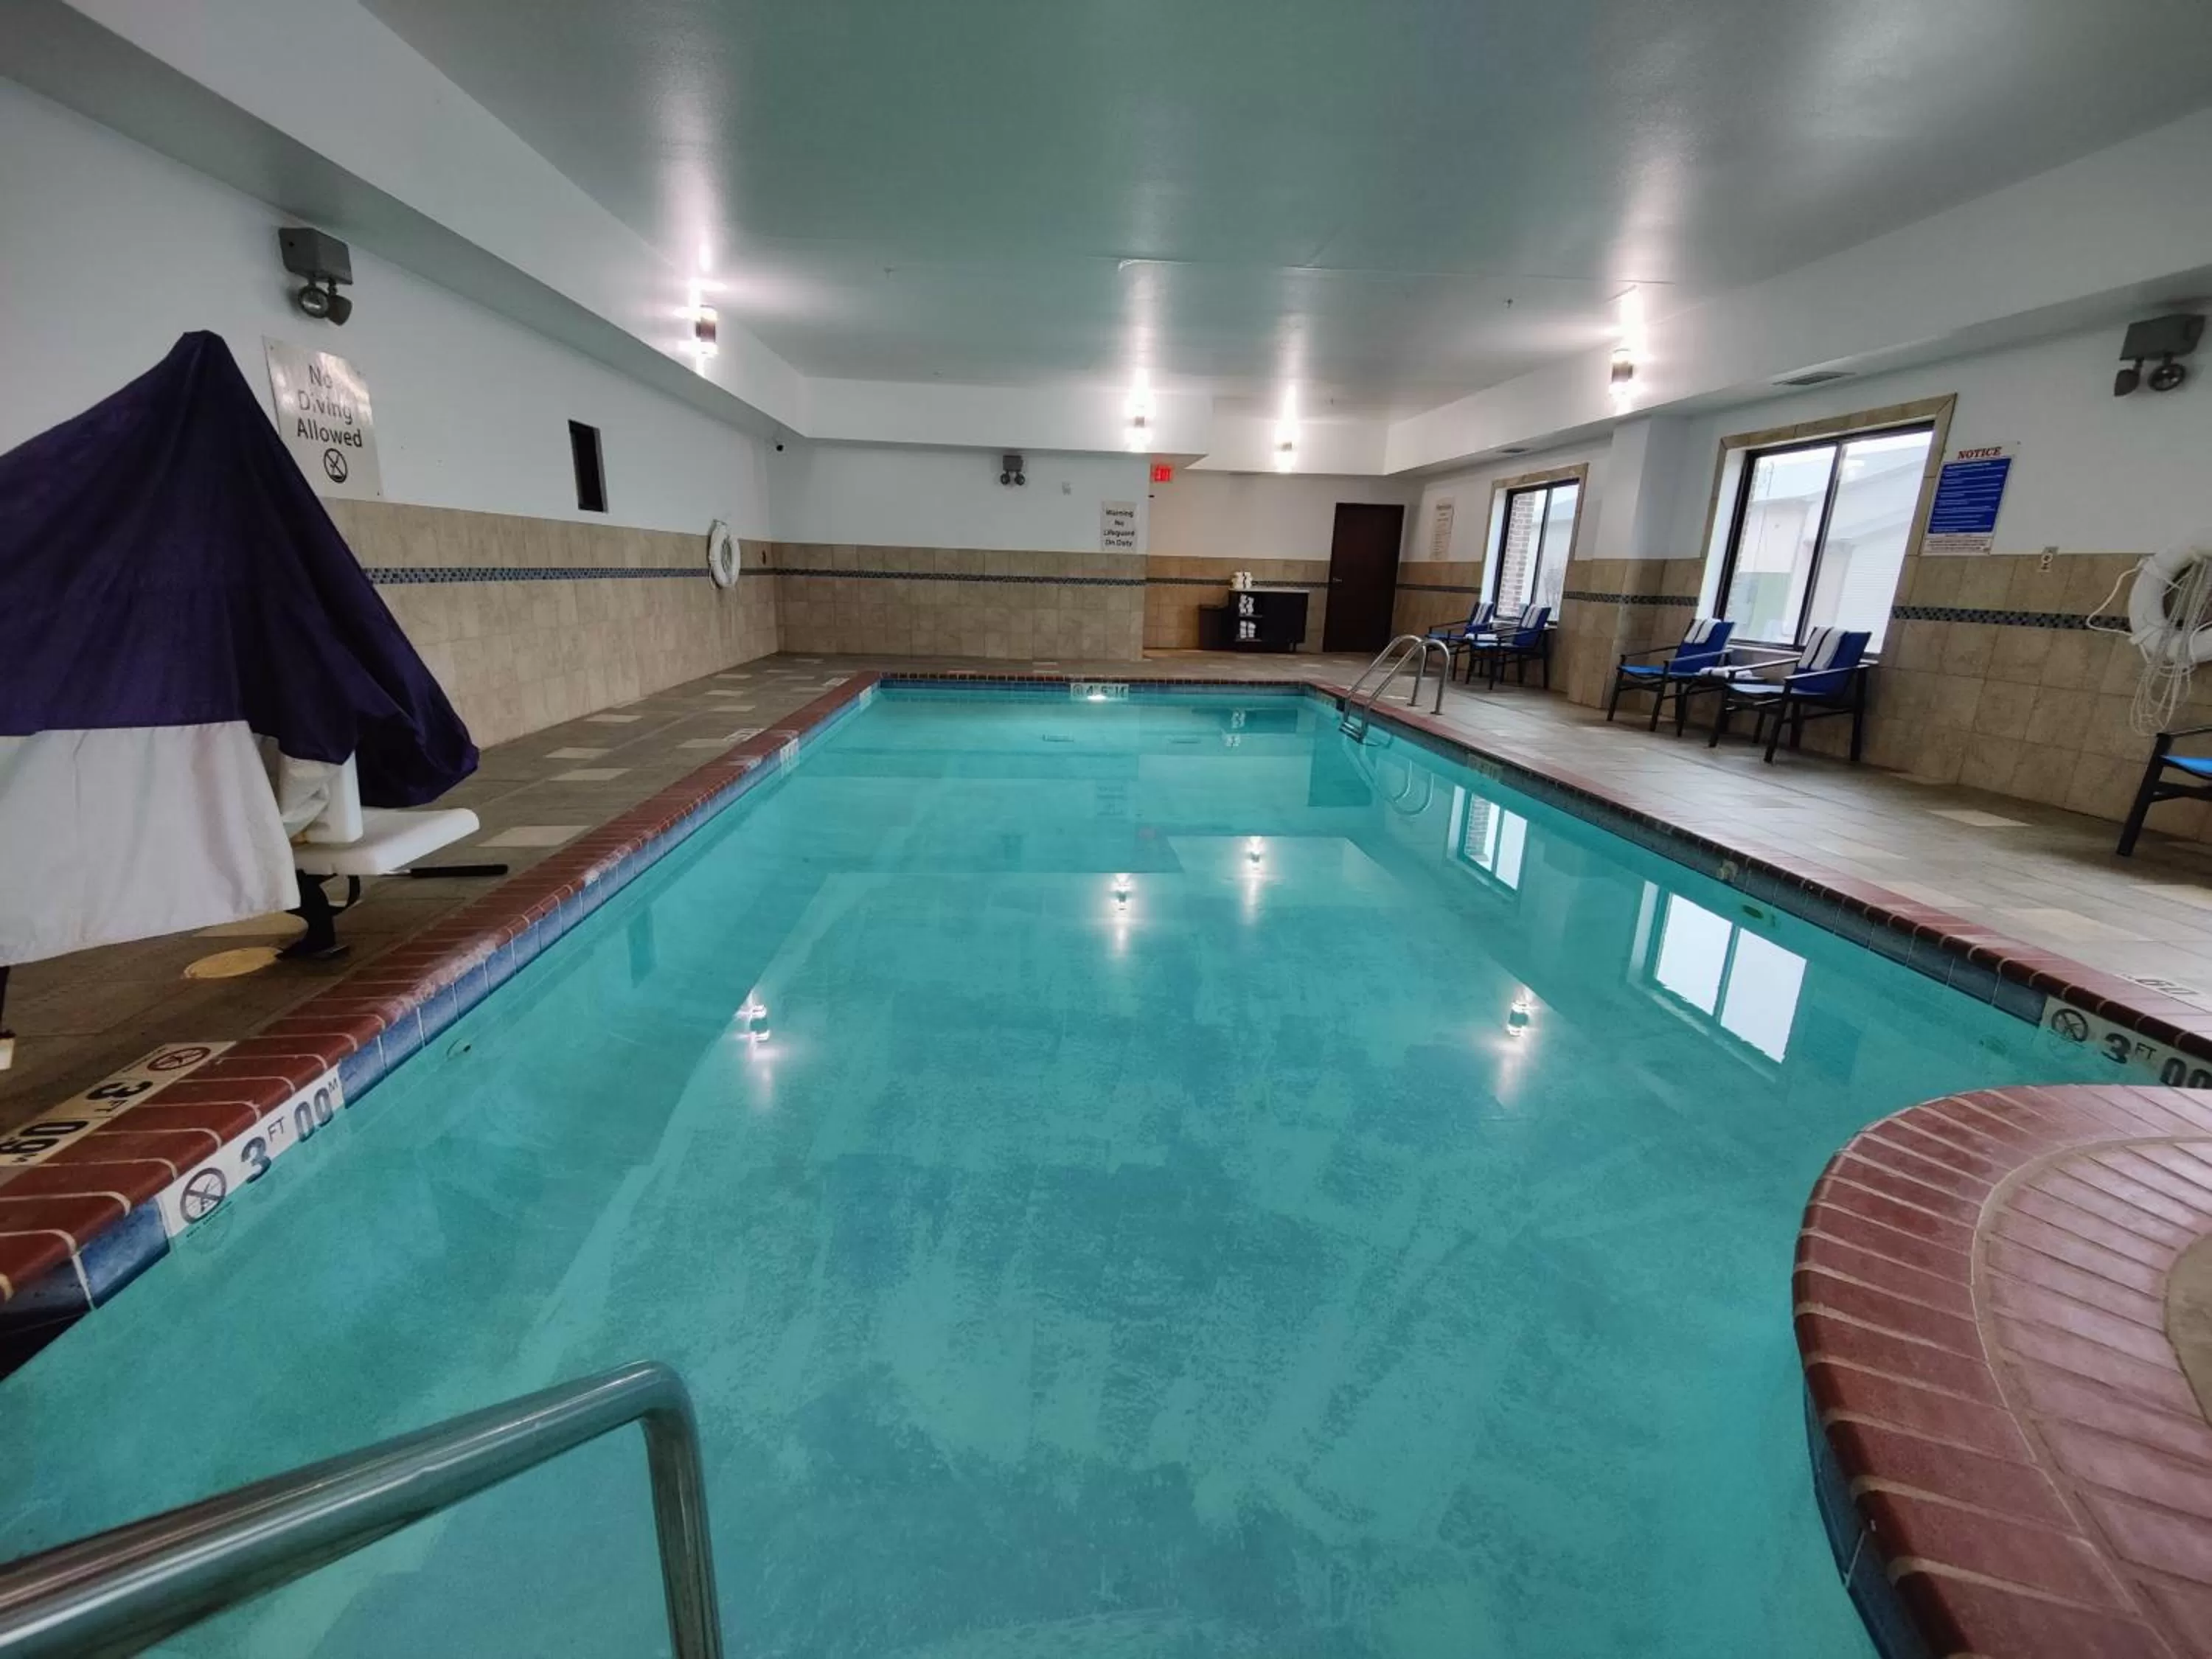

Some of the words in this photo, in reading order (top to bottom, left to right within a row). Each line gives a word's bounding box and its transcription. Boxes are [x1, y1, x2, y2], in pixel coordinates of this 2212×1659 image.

[310, 365, 334, 389] No
[297, 389, 353, 425] Diving
[297, 418, 362, 448] Allowed
[1958, 445, 2003, 460] NOTICE
[2101, 1033, 2132, 1064] 3
[2135, 1042, 2157, 1060] FT
[86, 1082, 153, 1100] 3
[241, 1136, 272, 1184] 3
[268, 1116, 285, 1142] FT
